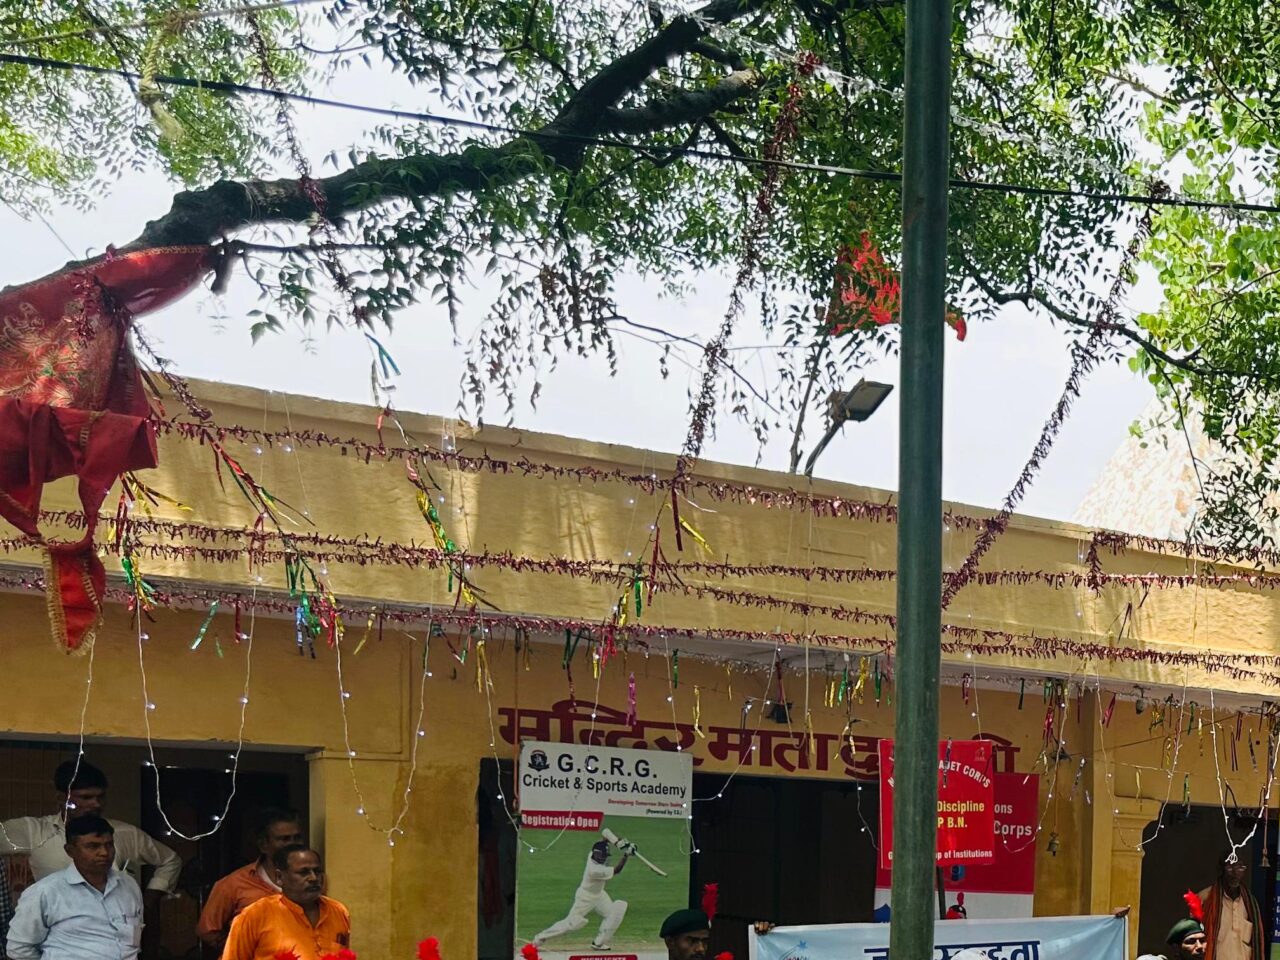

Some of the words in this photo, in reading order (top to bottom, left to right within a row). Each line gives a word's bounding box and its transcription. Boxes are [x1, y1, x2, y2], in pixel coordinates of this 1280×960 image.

[708, 726, 838, 772] माता
[557, 753, 657, 779] G.C.R.G.
[522, 774, 569, 790] Cricket
[573, 777, 583, 790] &
[586, 777, 628, 794] Sports
[630, 781, 687, 799] Academy
[937, 801, 985, 814] Discipline
[522, 814, 575, 827] Registration
[577, 816, 599, 828] Open
[953, 849, 992, 858] Institutions
